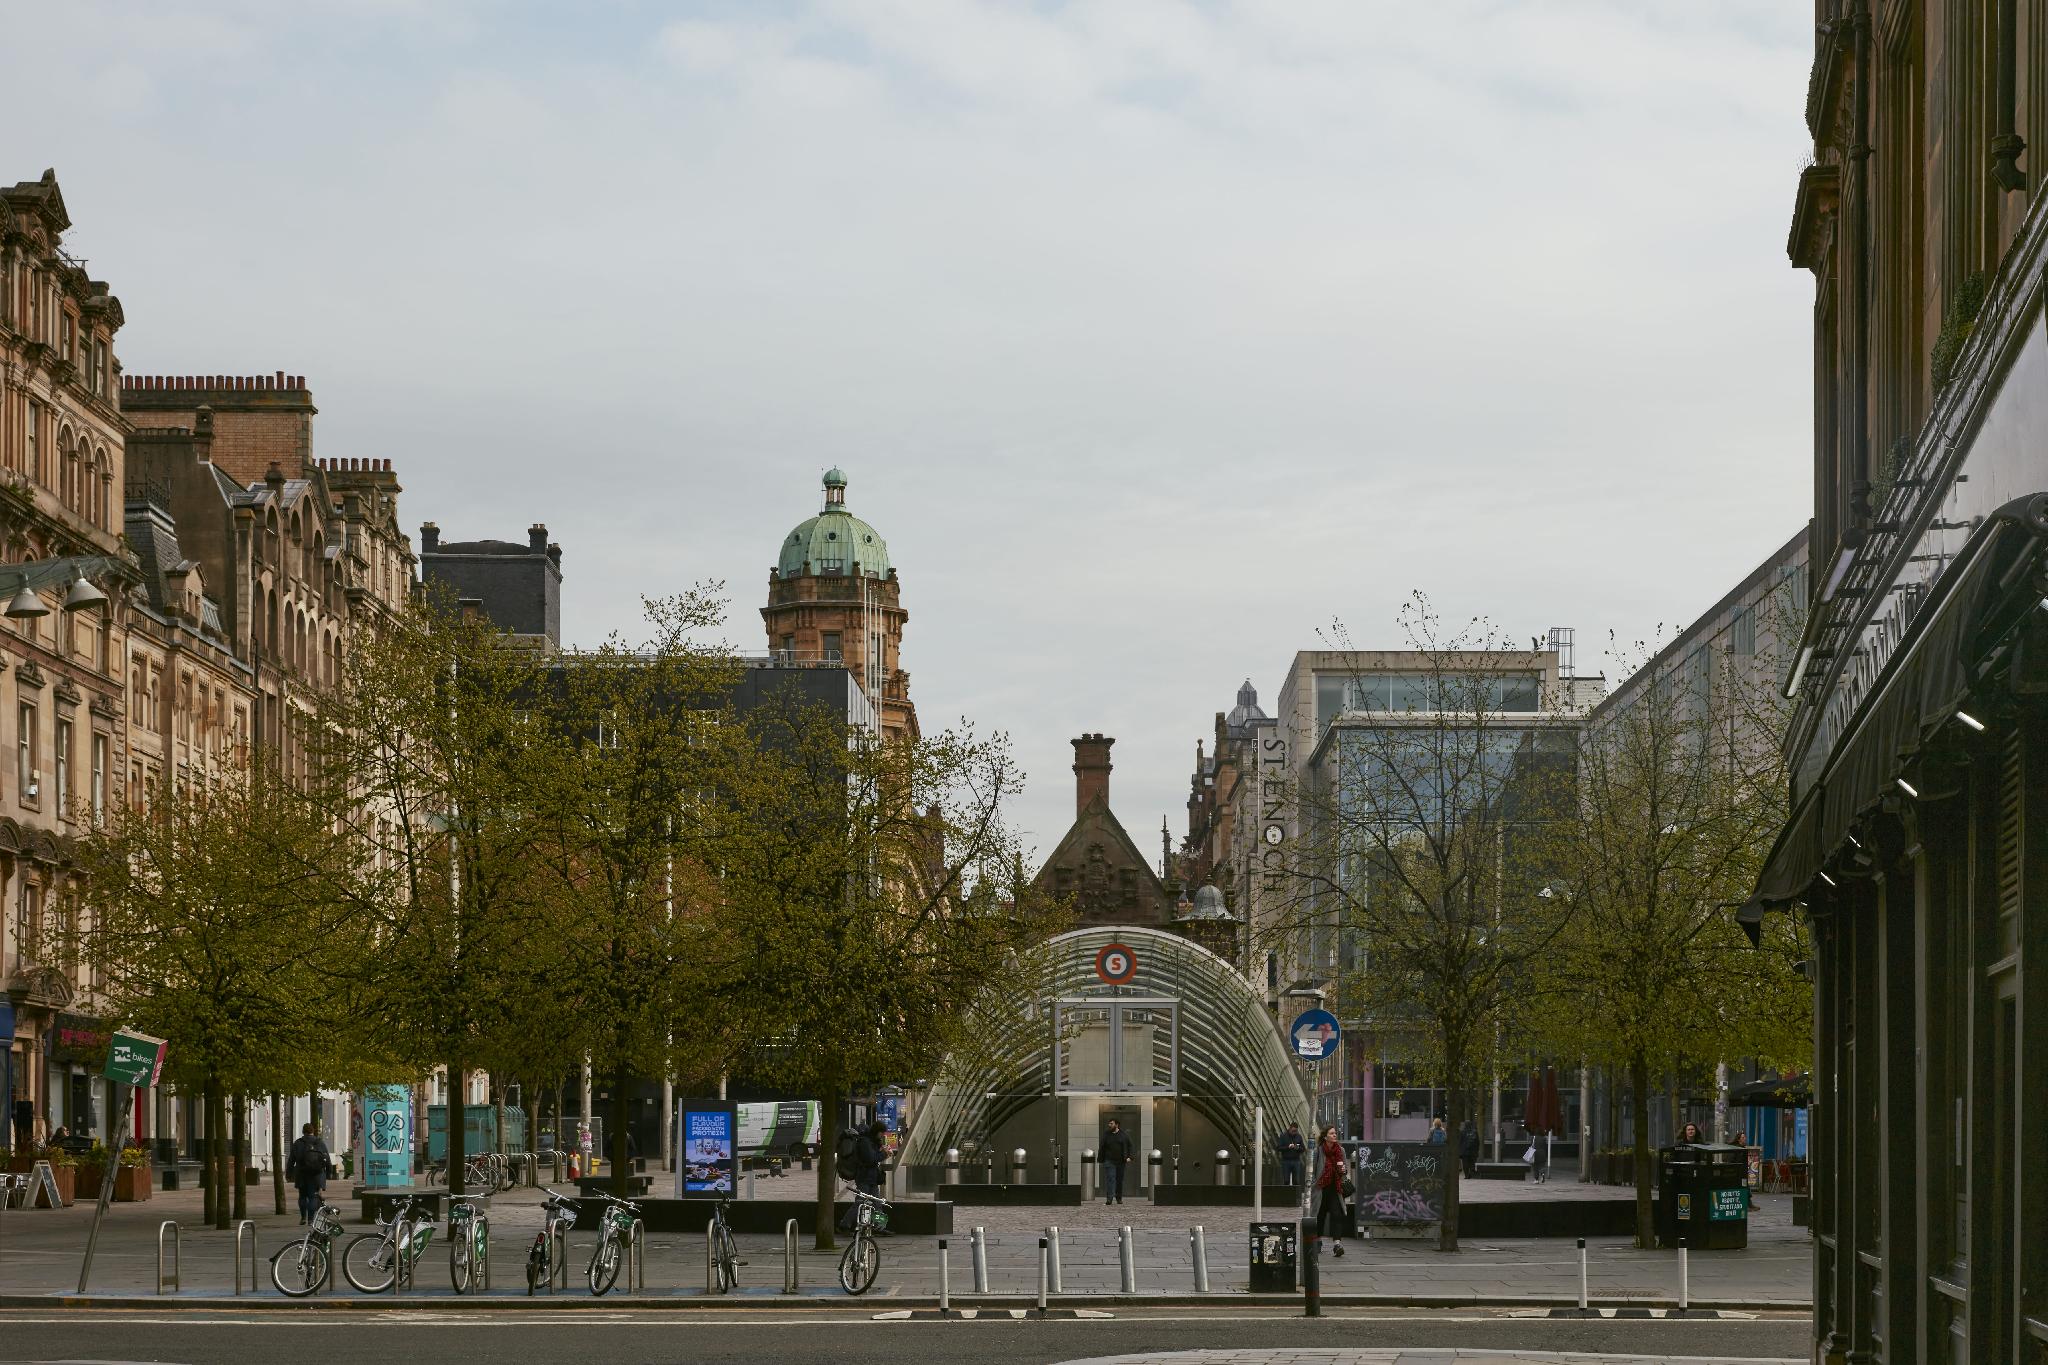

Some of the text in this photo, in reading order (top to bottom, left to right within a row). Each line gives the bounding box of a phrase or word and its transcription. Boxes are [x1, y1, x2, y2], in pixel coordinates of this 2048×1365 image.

[1264, 739, 1286, 893] ST ENOCH
[1111, 957, 1122, 971] S
[132, 1052, 153, 1065] bikes
